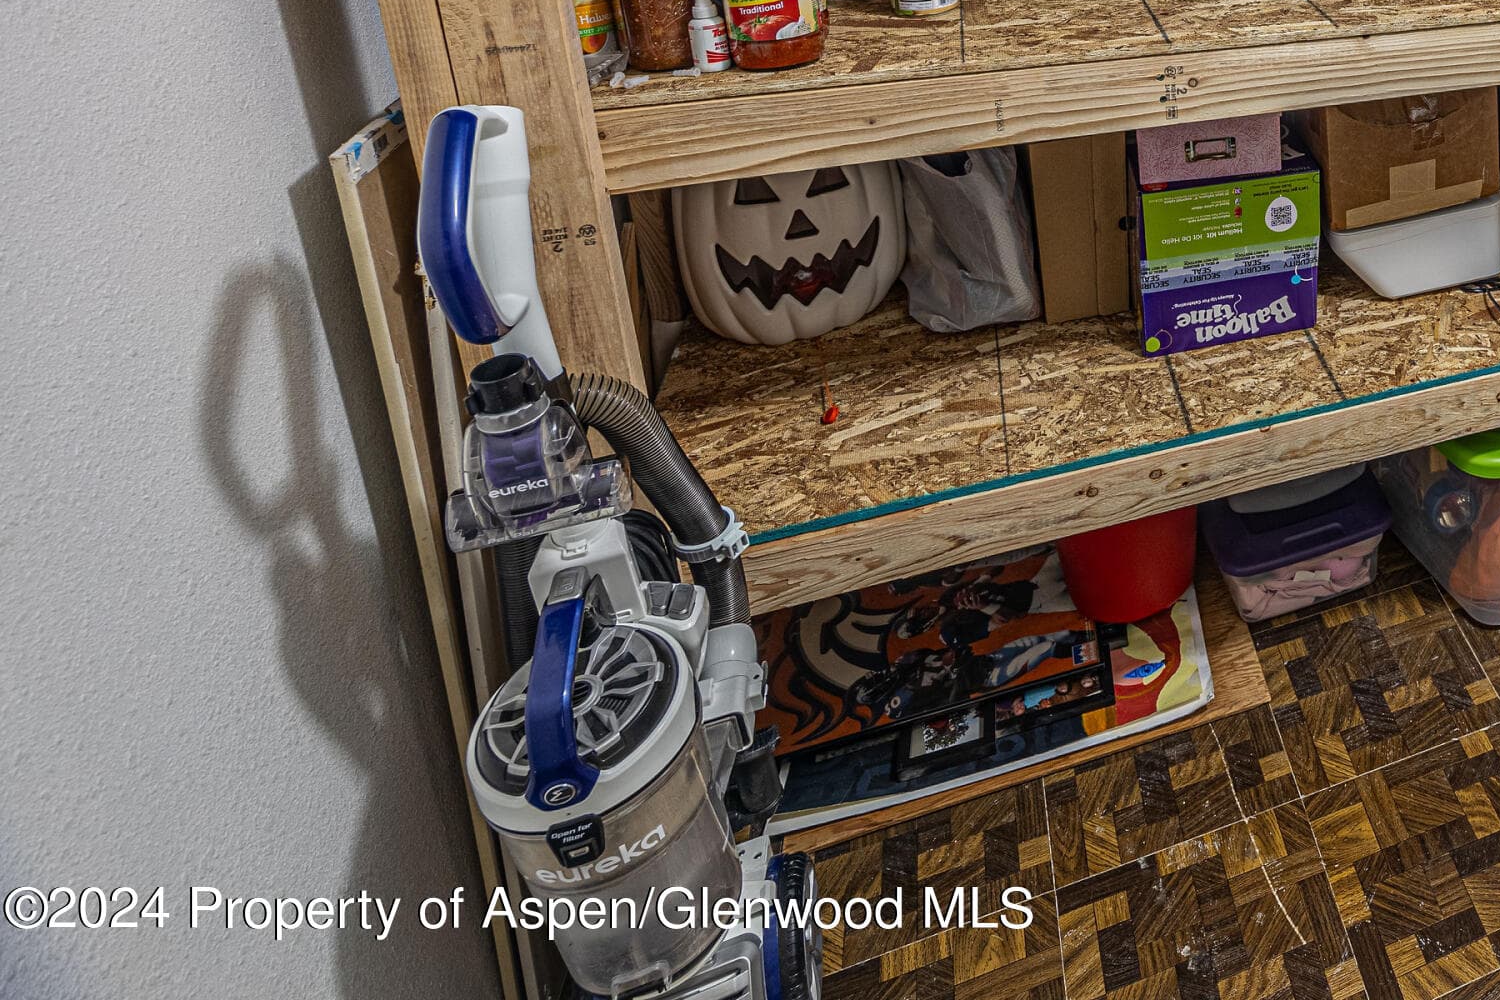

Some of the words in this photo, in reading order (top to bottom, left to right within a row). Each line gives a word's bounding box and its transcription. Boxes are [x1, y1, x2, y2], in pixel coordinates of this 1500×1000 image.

[738, 2, 784, 16] Traditional
[1206, 231, 1217, 239] Kit
[1216, 228, 1243, 237] Helium
[1291, 251, 1311, 260] SEAL
[1242, 258, 1262, 267] SEAL
[1283, 257, 1318, 269] SECURITY
[1191, 266, 1212, 275] SEAL
[1233, 264, 1271, 276] SECURITY
[1182, 273, 1221, 284] SECURITY
[1176, 303, 1235, 328] time
[1195, 295, 1297, 343] Balloon
[488, 477, 549, 499] eureka
[551, 828, 576, 840] Open
[577, 822, 593, 832] for
[562, 833, 586, 844] filter
[535, 823, 666, 884] eureka
